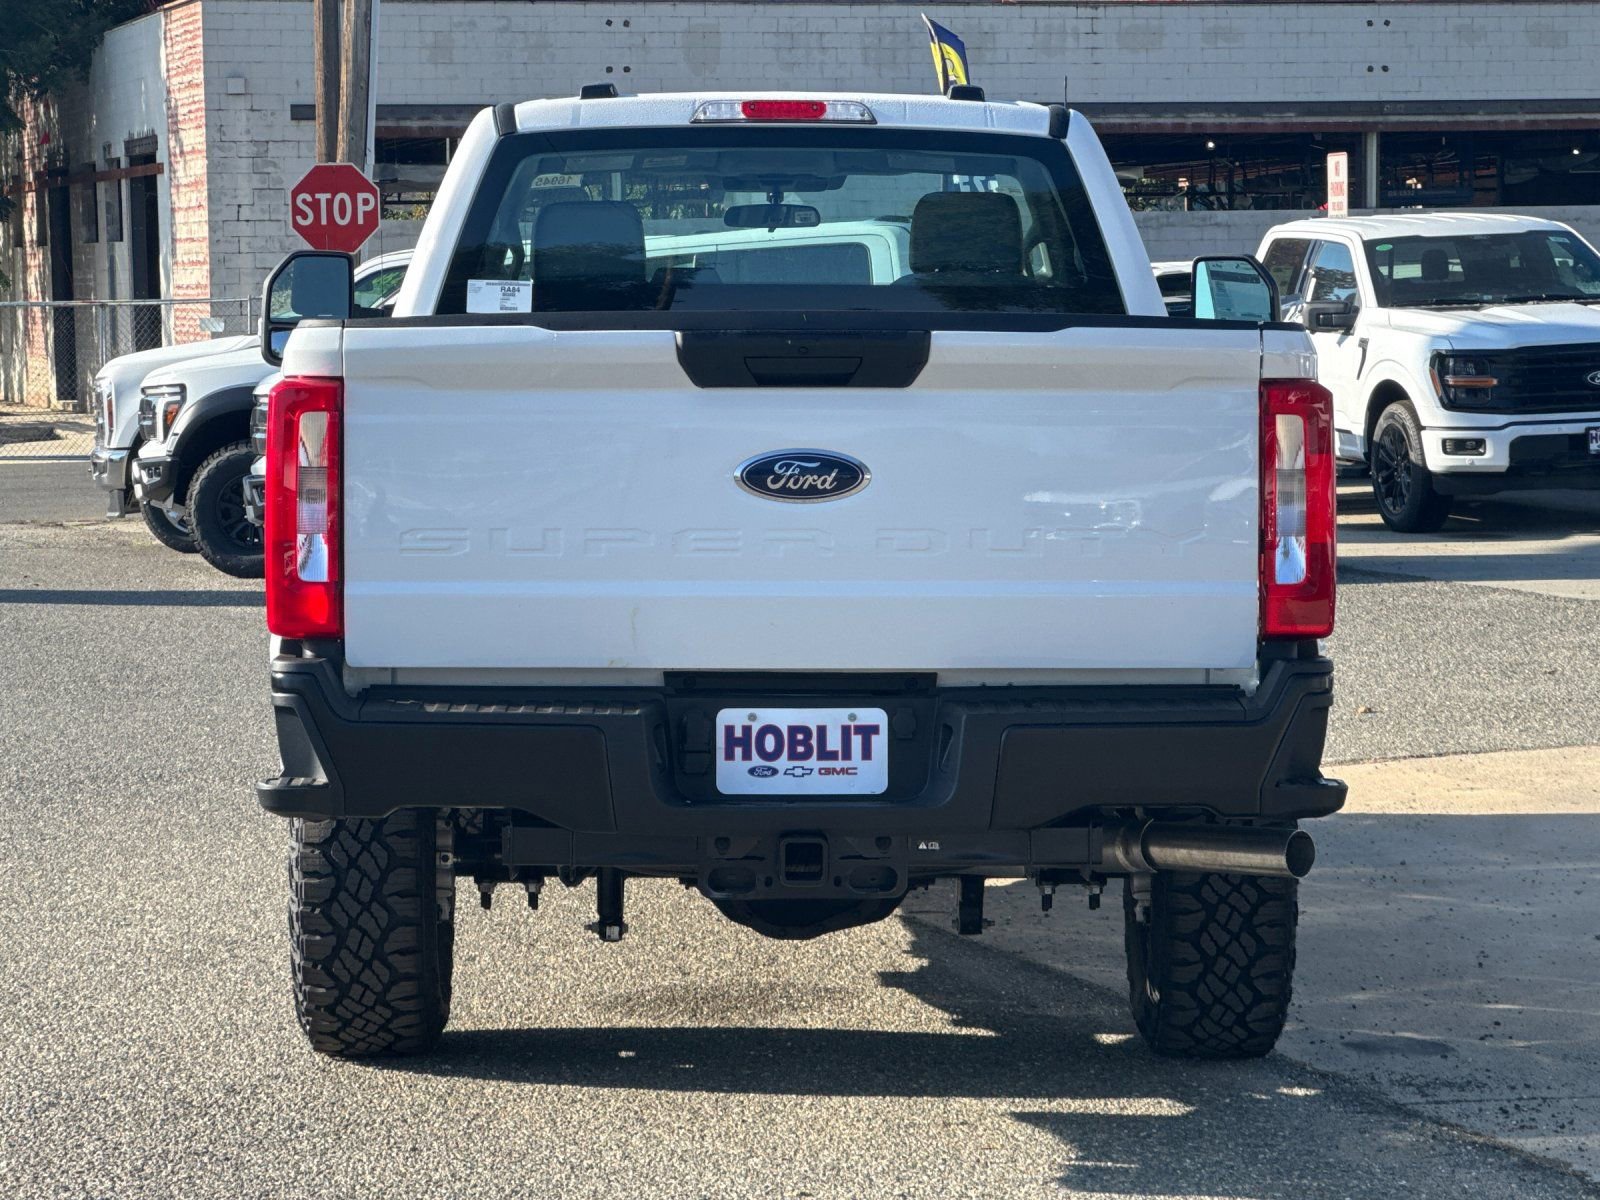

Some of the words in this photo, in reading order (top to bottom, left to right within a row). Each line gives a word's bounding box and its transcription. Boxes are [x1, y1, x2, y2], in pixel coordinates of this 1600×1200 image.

[295, 192, 376, 226] STOP
[766, 460, 839, 490] Ford
[399, 527, 836, 558] SUPER
[875, 527, 1207, 558] DUTY
[723, 724, 880, 762] HOBLIT
[818, 767, 858, 776] GMC
